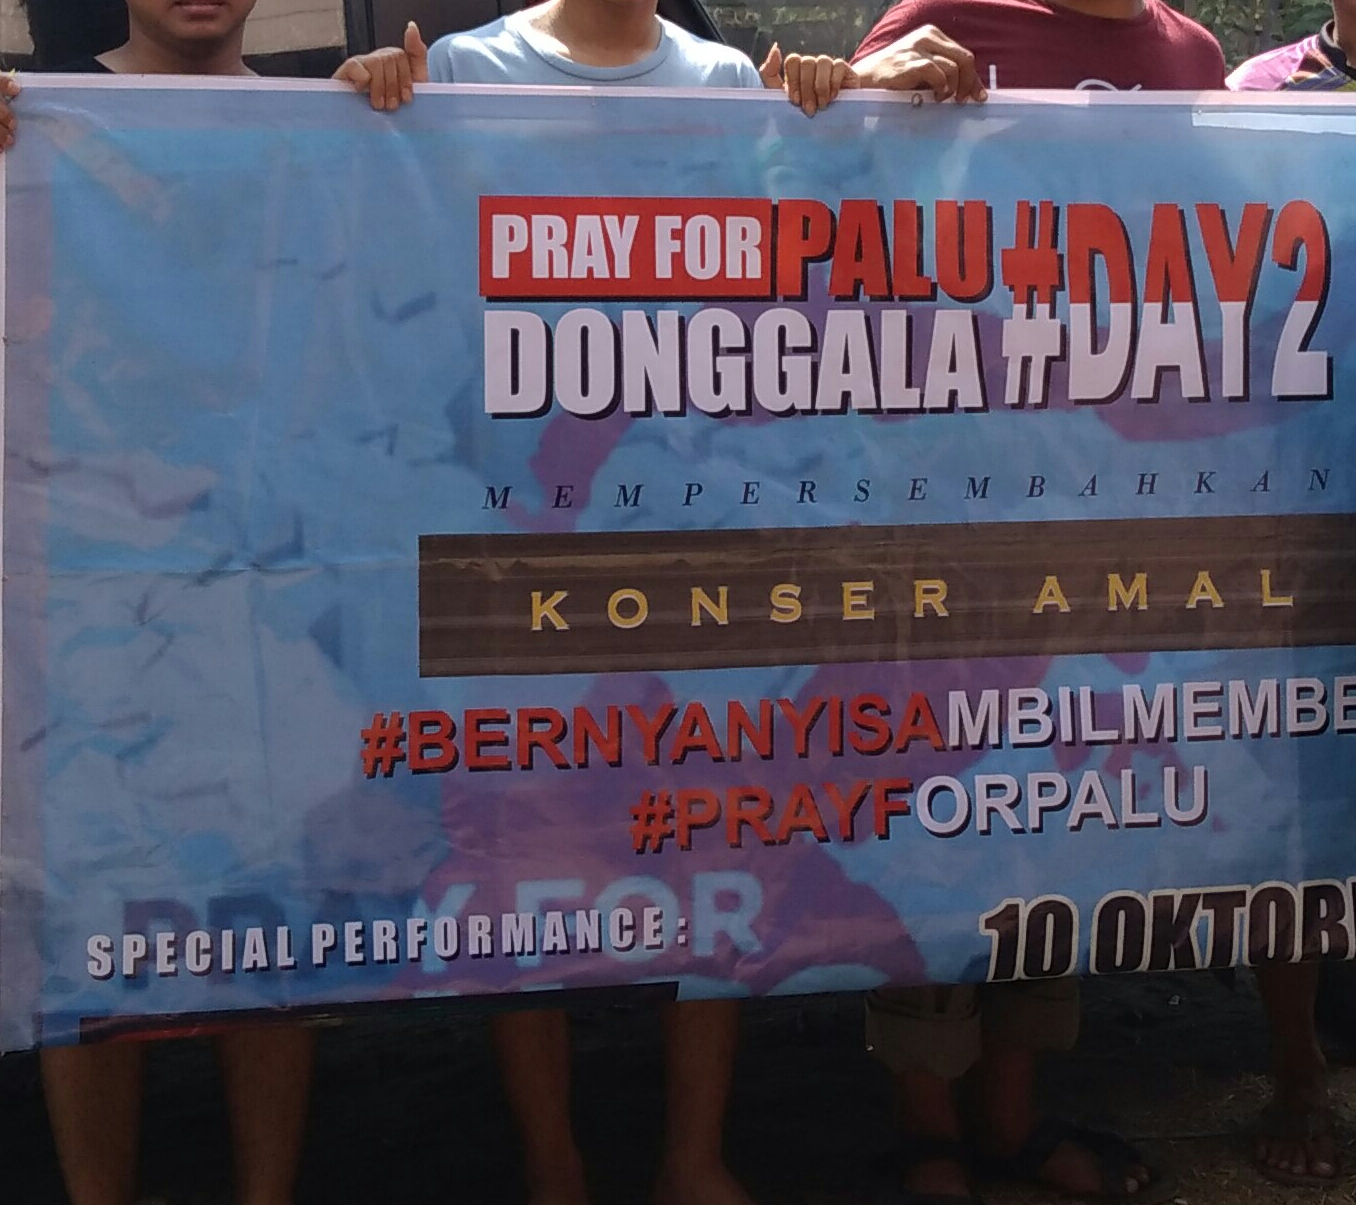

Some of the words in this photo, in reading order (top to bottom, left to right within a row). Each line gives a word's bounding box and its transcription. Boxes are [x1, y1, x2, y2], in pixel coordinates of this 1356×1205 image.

[491, 214, 639, 279] PRAY
[655, 214, 763, 280] FOR
[777, 199, 993, 299] PALU
[484, 307, 988, 418] DONGGALA
[481, 467, 1332, 511] MEMPERSEMBAHKAN
[530, 578, 950, 634] KONSER
[1033, 569, 1295, 620] AMAL
[628, 764, 1210, 854] #PRAYFORPALU
[85, 923, 301, 980] SPECIAL
[980, 897, 1076, 982] 10
